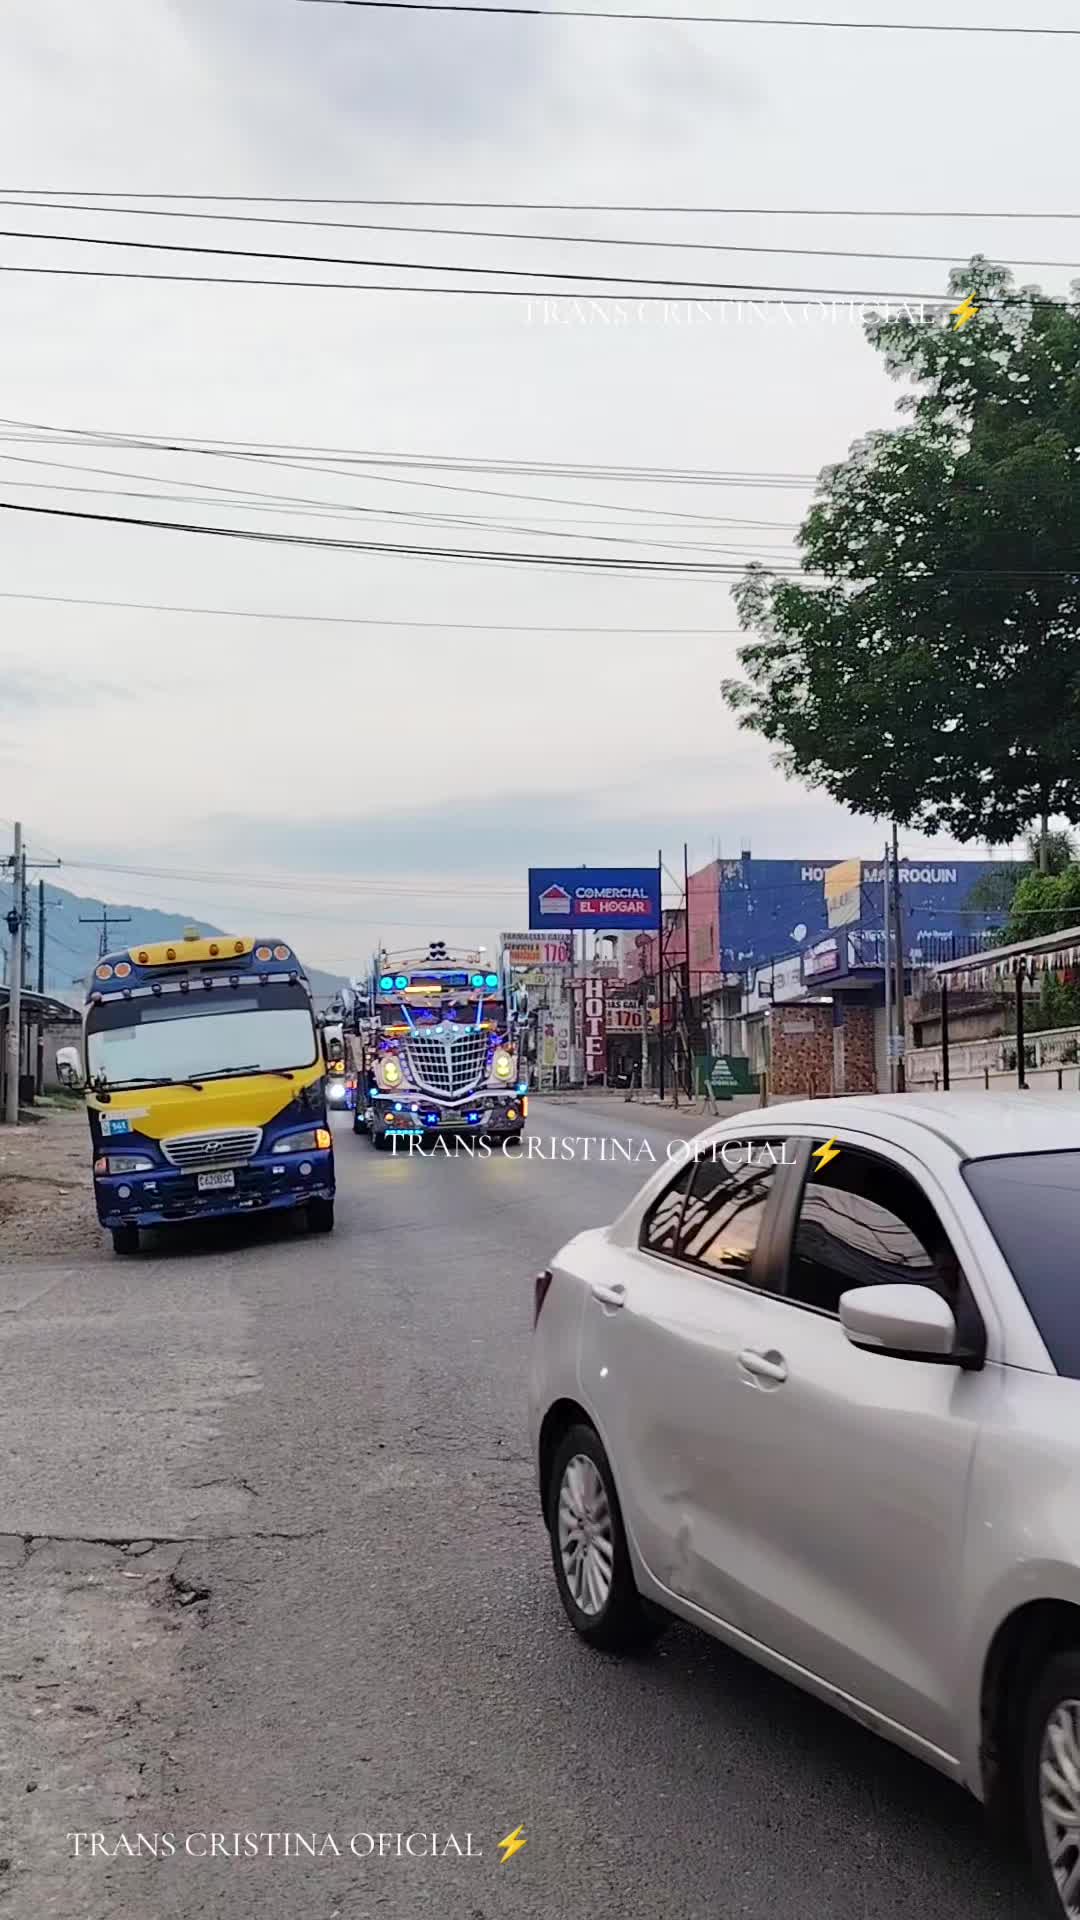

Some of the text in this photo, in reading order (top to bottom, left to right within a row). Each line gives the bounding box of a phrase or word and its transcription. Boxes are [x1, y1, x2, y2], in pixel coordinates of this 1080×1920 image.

[575, 887, 648, 899] COMERCIAL
[580, 901, 645, 912] EL HOGAR
